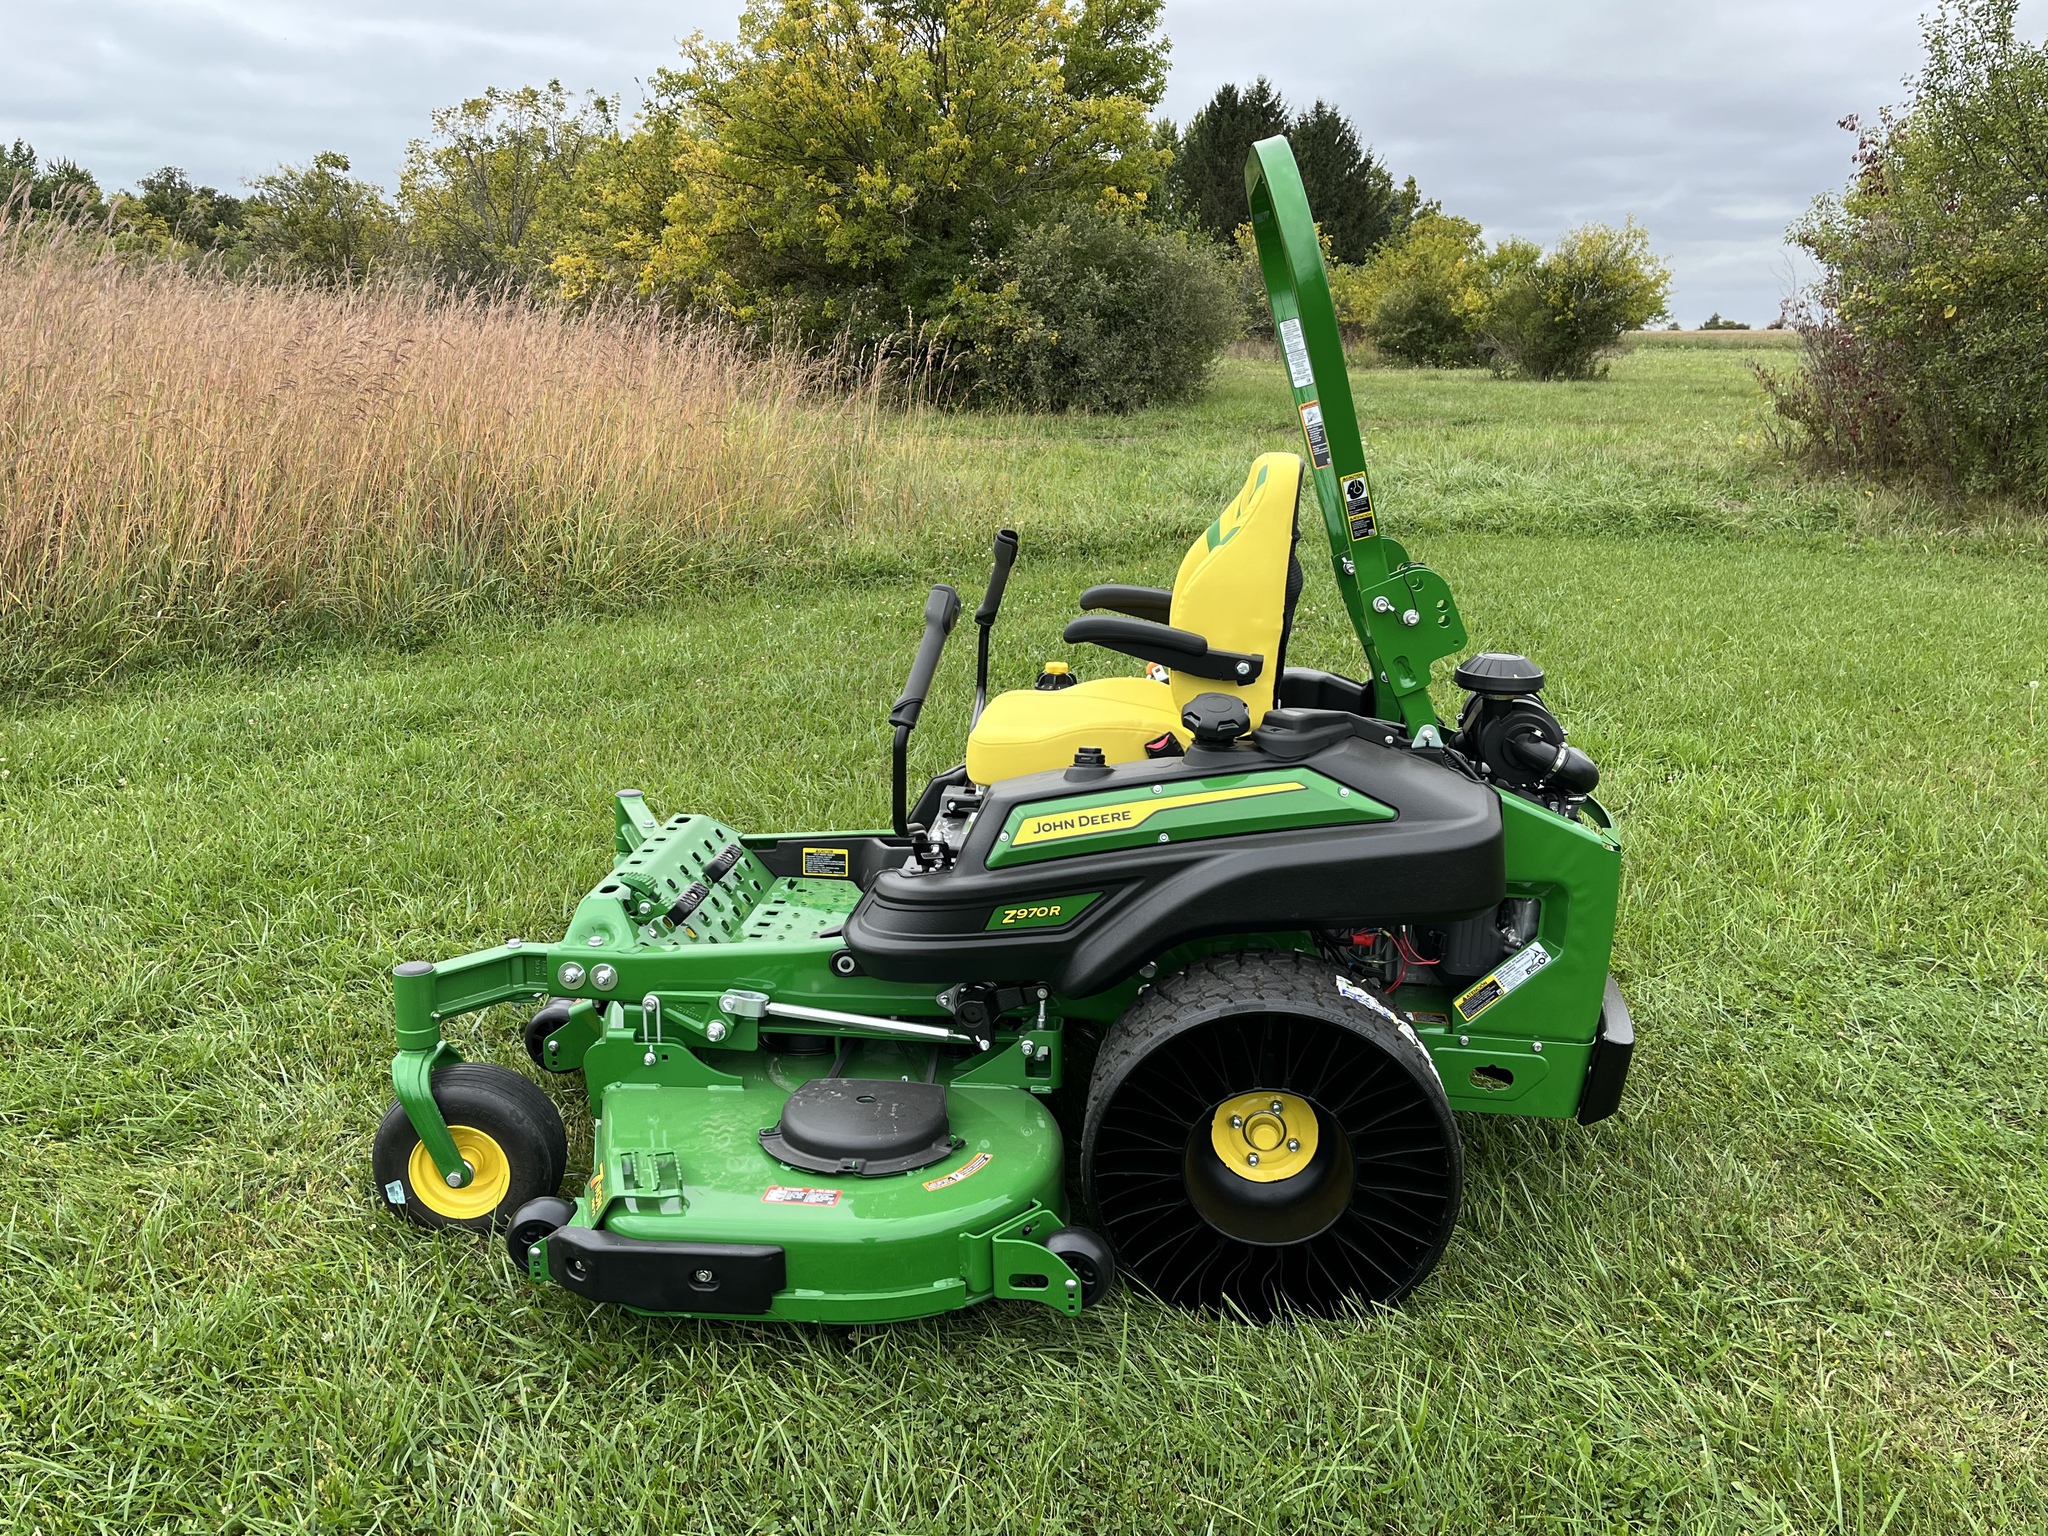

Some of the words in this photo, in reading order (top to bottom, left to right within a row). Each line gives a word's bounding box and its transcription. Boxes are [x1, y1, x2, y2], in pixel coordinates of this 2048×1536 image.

[1033, 819, 1075, 834] JOHN
[1078, 811, 1131, 827] DEERE
[1001, 906, 1061, 924] Z970R
[1316, 1011, 1376, 1039] MICHELIN
